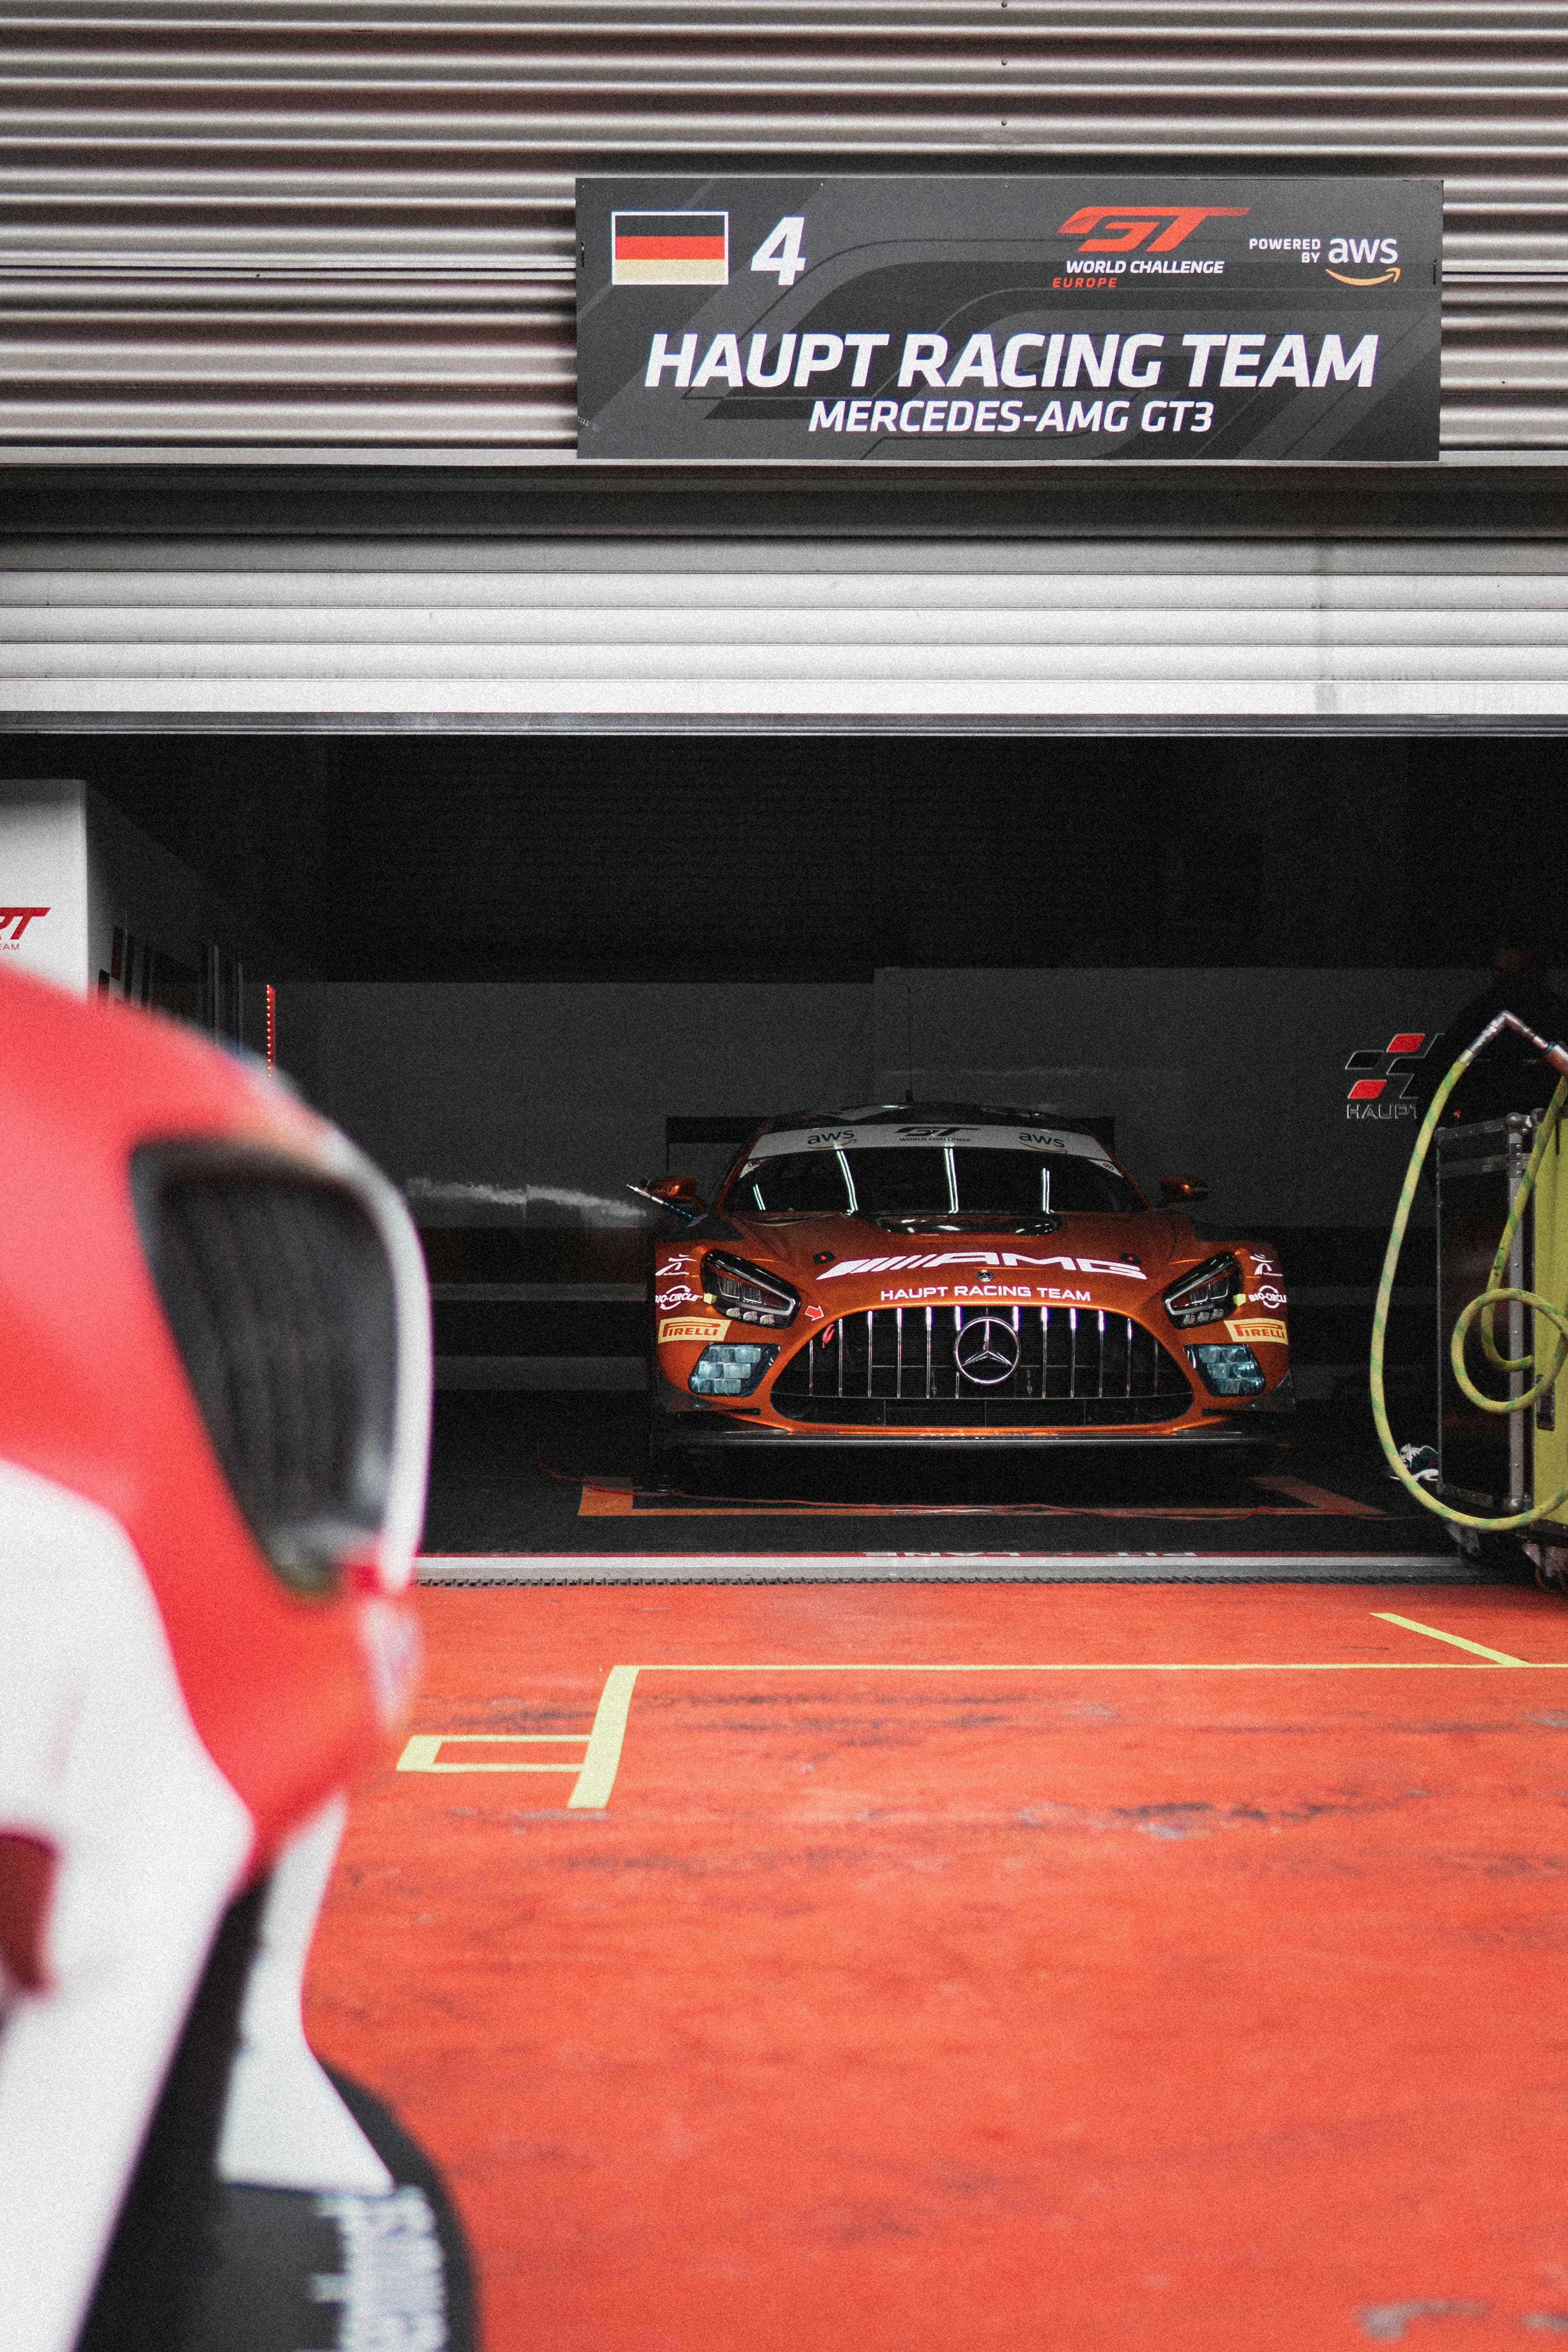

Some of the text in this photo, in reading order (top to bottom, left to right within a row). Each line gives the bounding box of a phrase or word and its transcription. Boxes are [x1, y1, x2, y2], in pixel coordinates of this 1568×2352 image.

[1056, 207, 1252, 251] GT
[751, 217, 806, 285] 4
[1249, 238, 1321, 250] POWERED
[1328, 238, 1398, 264] aws
[1301, 252, 1320, 263] BY
[1066, 260, 1225, 274] WORLD CHALLENGE
[1052, 277, 1117, 288] EUROPE
[644, 333, 1379, 388] HAUPT RACING TEAM
[808, 401, 1214, 433] MERCEDES-AMG GT3
[807, 1130, 855, 1145] aws
[1019, 1132, 1065, 1148] aws
[924, 1252, 1147, 1279] AMG
[881, 1285, 1090, 1301] HAUPT RACING TEAM
[662, 1321, 721, 1338] PIRELLI
[1234, 1322, 1284, 1338] PIRELLI
